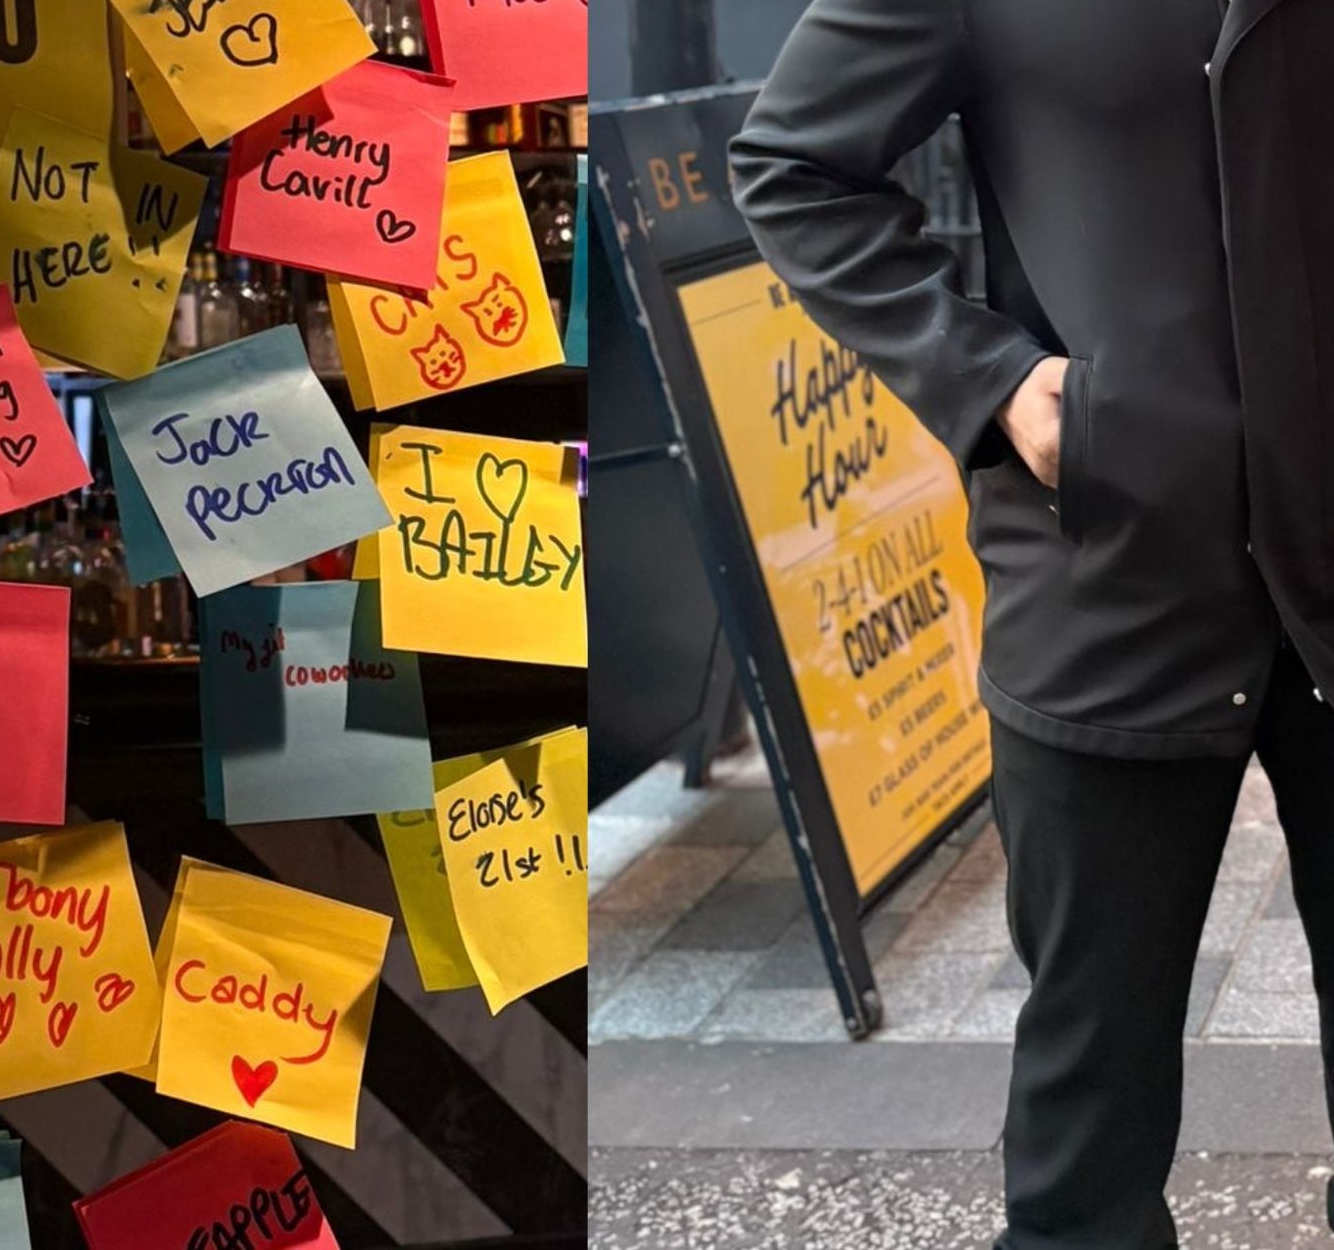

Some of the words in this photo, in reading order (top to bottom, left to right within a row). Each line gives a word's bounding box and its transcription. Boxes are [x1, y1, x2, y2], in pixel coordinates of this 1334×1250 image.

[10, 145, 100, 204] NOT
[135, 182, 179, 232] IN
[260, 149, 373, 210] Cavill
[281, 113, 390, 185] Henry
[370, 234, 478, 336] CS
[400, 441, 456, 505] I
[801, 415, 888, 530] Hour
[902, 508, 945, 567] ALL
[842, 567, 951, 681] COCKTAILS
[174, 958, 338, 1065] Caddy
